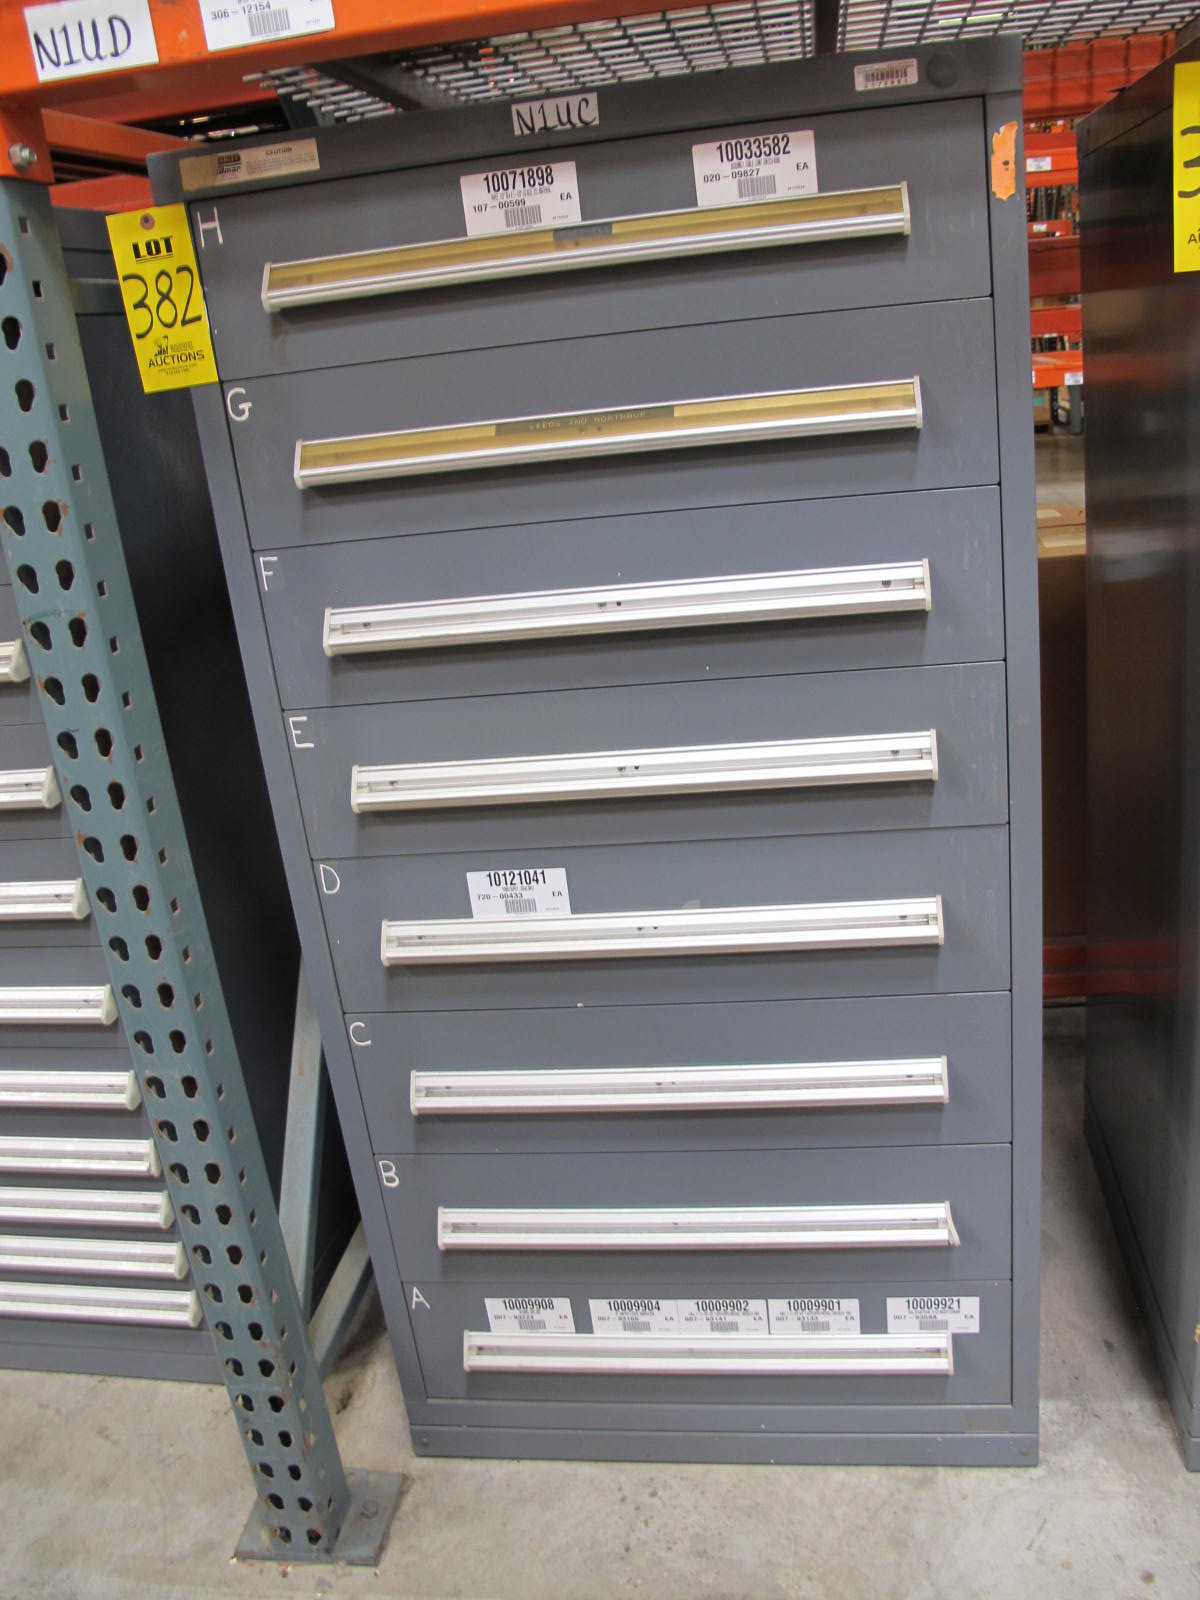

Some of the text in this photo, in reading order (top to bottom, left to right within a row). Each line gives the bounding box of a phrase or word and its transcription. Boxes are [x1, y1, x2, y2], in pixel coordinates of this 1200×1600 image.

[34, 15, 131, 70] N1UD
[515, 97, 597, 136] N1UC
[716, 134, 791, 163] 10033582
[483, 165, 554, 194] 10071898
[796, 162, 809, 172] EA
[560, 191, 572, 201] EA
[197, 207, 224, 248] H
[132, 236, 174, 259] LOT
[122, 264, 202, 339] 382
[149, 350, 205, 368] AUCTIONS
[226, 387, 252, 421] G
[259, 556, 278, 592] F
[289, 716, 315, 748] E
[320, 864, 341, 895] D
[486, 869, 547, 887] 10121041
[349, 1021, 372, 1047] C
[379, 1160, 399, 1188] B
[411, 1286, 431, 1310] A
[502, 1298, 555, 1311] 10009908
[606, 1299, 661, 1312] 10009904
[694, 1299, 750, 1312] 10009902
[787, 1299, 841, 1312] 10009901
[905, 1297, 961, 1310] 10009921
